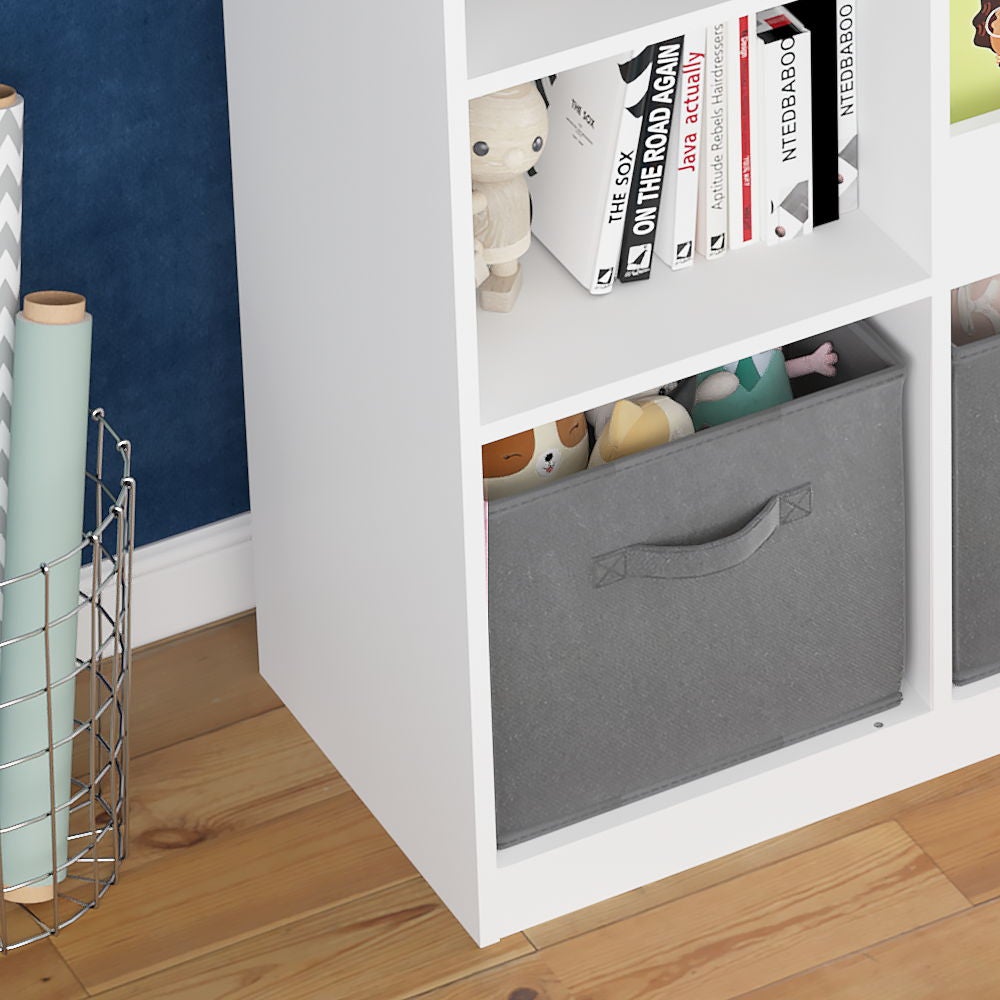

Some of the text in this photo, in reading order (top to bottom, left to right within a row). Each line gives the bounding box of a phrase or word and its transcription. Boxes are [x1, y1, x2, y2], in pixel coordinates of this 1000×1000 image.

[652, 43, 681, 104] AGAIN
[839, 3, 855, 118] NTEDBABOO
[643, 106, 672, 163] ROAD
[678, 51, 705, 172] Java actually
[709, 23, 725, 211] Aptitude Rebels Hairdressers
[608, 150, 635, 224] THE SOX
[637, 165, 663, 205] THE
[632, 207, 658, 236] ON
